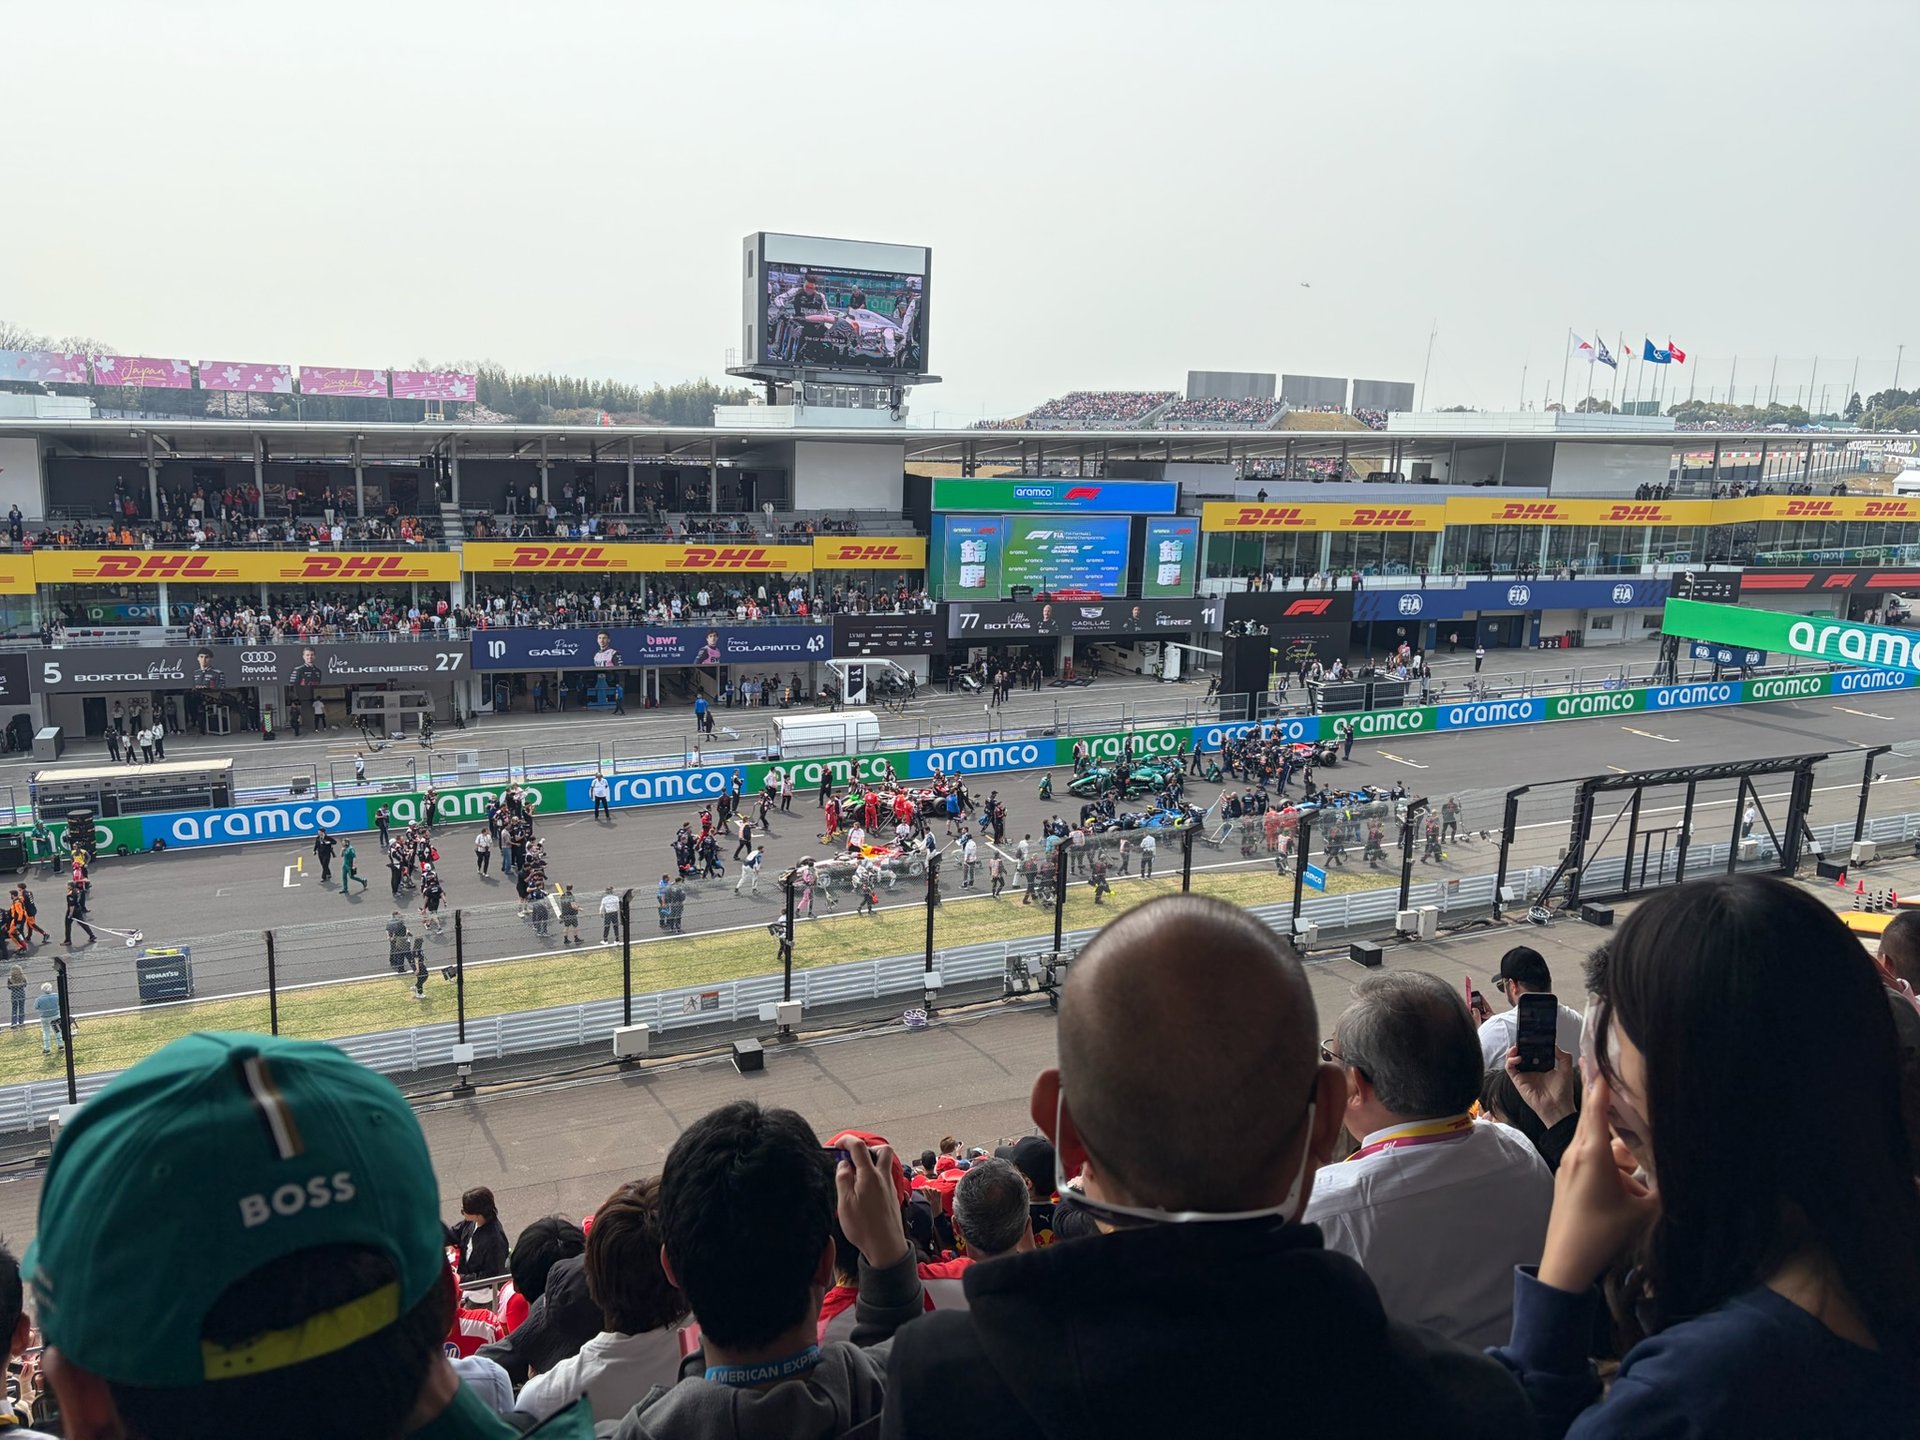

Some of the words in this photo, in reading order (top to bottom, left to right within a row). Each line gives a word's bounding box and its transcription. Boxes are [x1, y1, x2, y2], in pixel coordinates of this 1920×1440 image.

[121, 359, 166, 381] Japan
[1016, 488, 1052, 497] aramco
[1237, 508, 1303, 526] DHL
[1502, 504, 1559, 520] DHL
[1609, 505, 1662, 520] DHL
[1786, 501, 1834, 516] DHL
[1864, 502, 1908, 516] DHL
[1351, 510, 1415, 527] DHL
[512, 547, 608, 567] DHL
[682, 549, 771, 568] DHL
[838, 545, 901, 560] DHL
[96, 556, 217, 577] DHL
[302, 556, 410, 577] DHL
[1822, 574, 1857, 588] F1
[1508, 587, 1529, 604] FIA
[1612, 585, 1633, 603] FIA
[1283, 599, 1334, 616] F1
[1400, 595, 1422, 613] FIA
[960, 613, 980, 629] 77
[1201, 608, 1216, 624] 11
[488, 640, 506, 659] 10
[655, 636, 678, 645] BWT
[727, 644, 801, 653] COLAPINTO
[806, 634, 824, 652] 43
[528, 648, 578, 657] GASLY
[1718, 651, 1732, 662] FIA
[1745, 652, 1759, 664] FIA
[241, 665, 277, 673] Revolut
[329, 664, 429, 674] HULKENBERG
[435, 653, 464, 672] 27
[44, 662, 62, 684] 5
[74, 672, 185, 682] BORTOLETO
[1842, 671, 1905, 689] aramco
[1657, 685, 1731, 706] aramco
[1752, 677, 1821, 698] aramco
[1450, 702, 1532, 725] aramco
[1557, 693, 1634, 716] aramco
[1333, 711, 1423, 735] aramco
[927, 744, 1039, 771] aramco
[172, 804, 341, 841] aramco
[146, 971, 179, 980] KOMATSU
[239, 1171, 356, 1228] BOSS
[710, 1365, 779, 1383] AMERICAN
